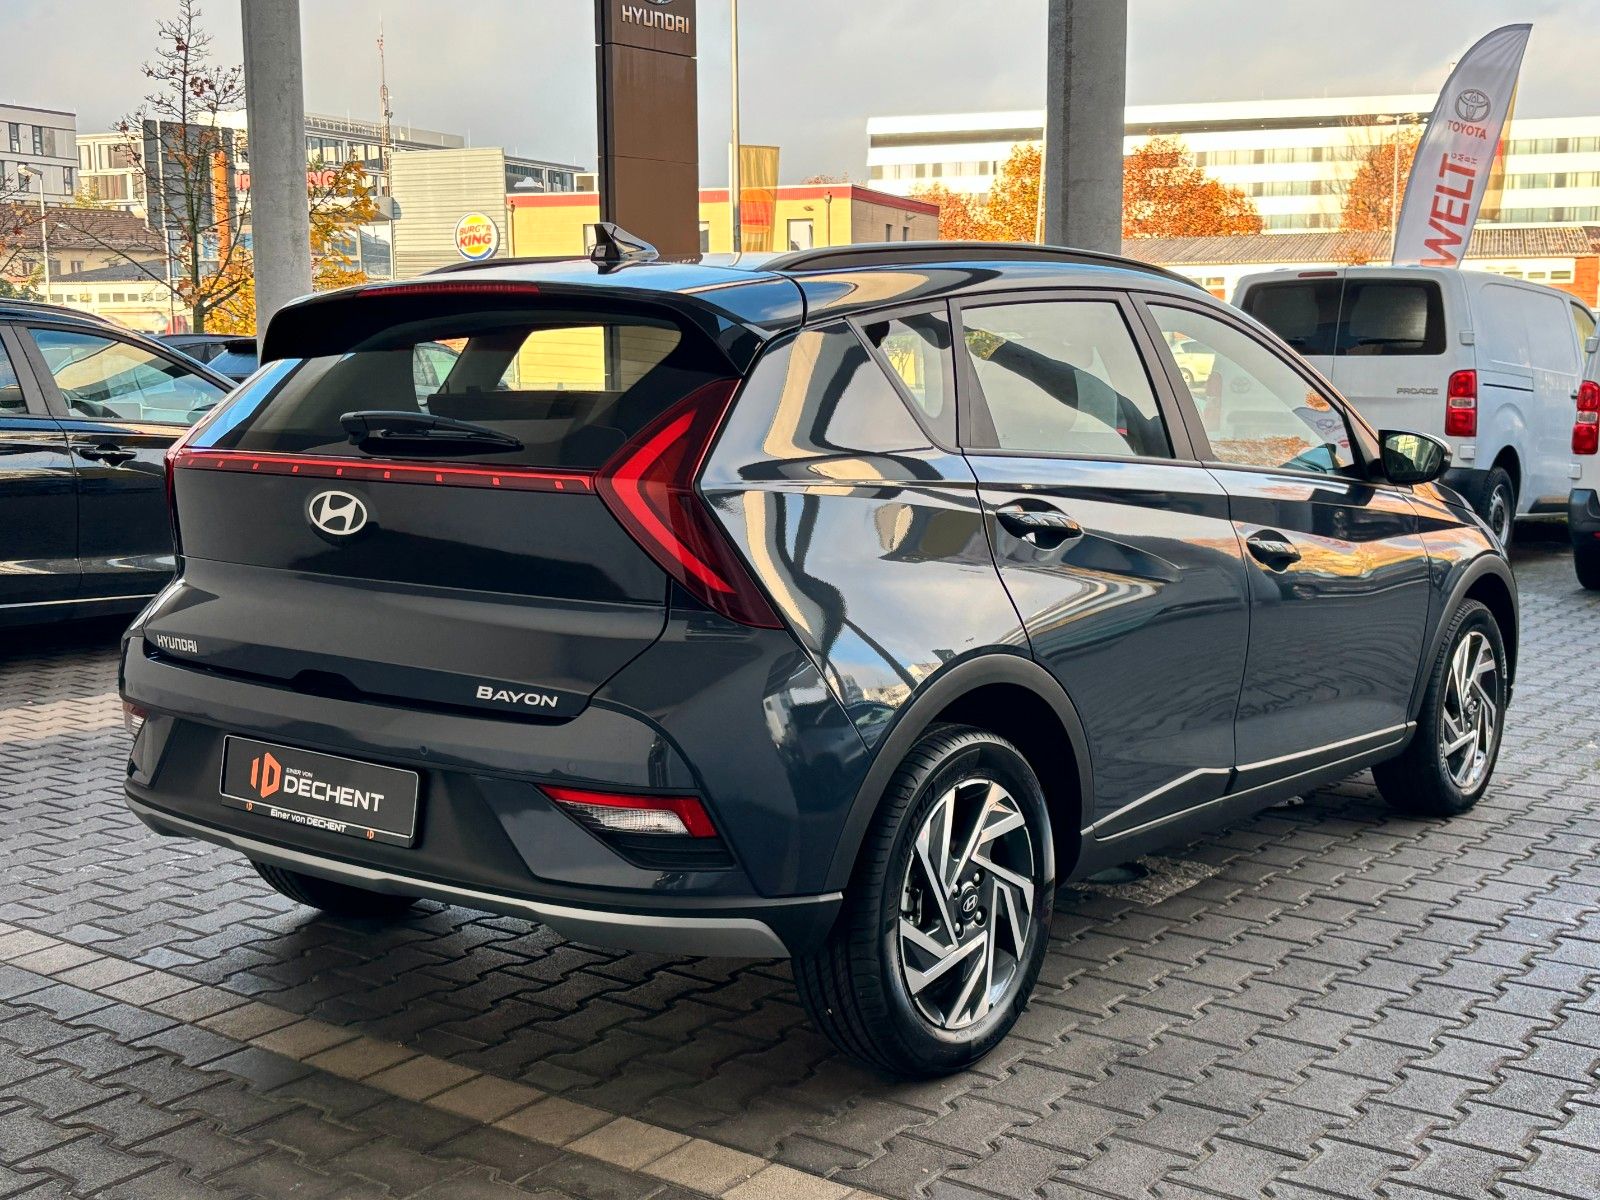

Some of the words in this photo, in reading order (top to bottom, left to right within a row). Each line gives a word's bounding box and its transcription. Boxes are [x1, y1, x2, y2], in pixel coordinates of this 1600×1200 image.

[621, 4, 689, 34] HYUNDAI
[1447, 119, 1487, 140] TOYOTA
[1420, 152, 1477, 267] WELT
[460, 233, 492, 247] KING
[1396, 387, 1439, 395] PROACE
[156, 634, 198, 653] HYUNDAI
[476, 685, 559, 708] BAYON
[283, 775, 385, 812] DECHENT
[270, 808, 290, 820] Einer
[291, 814, 306, 824] von
[306, 816, 347, 833] DECHENT
